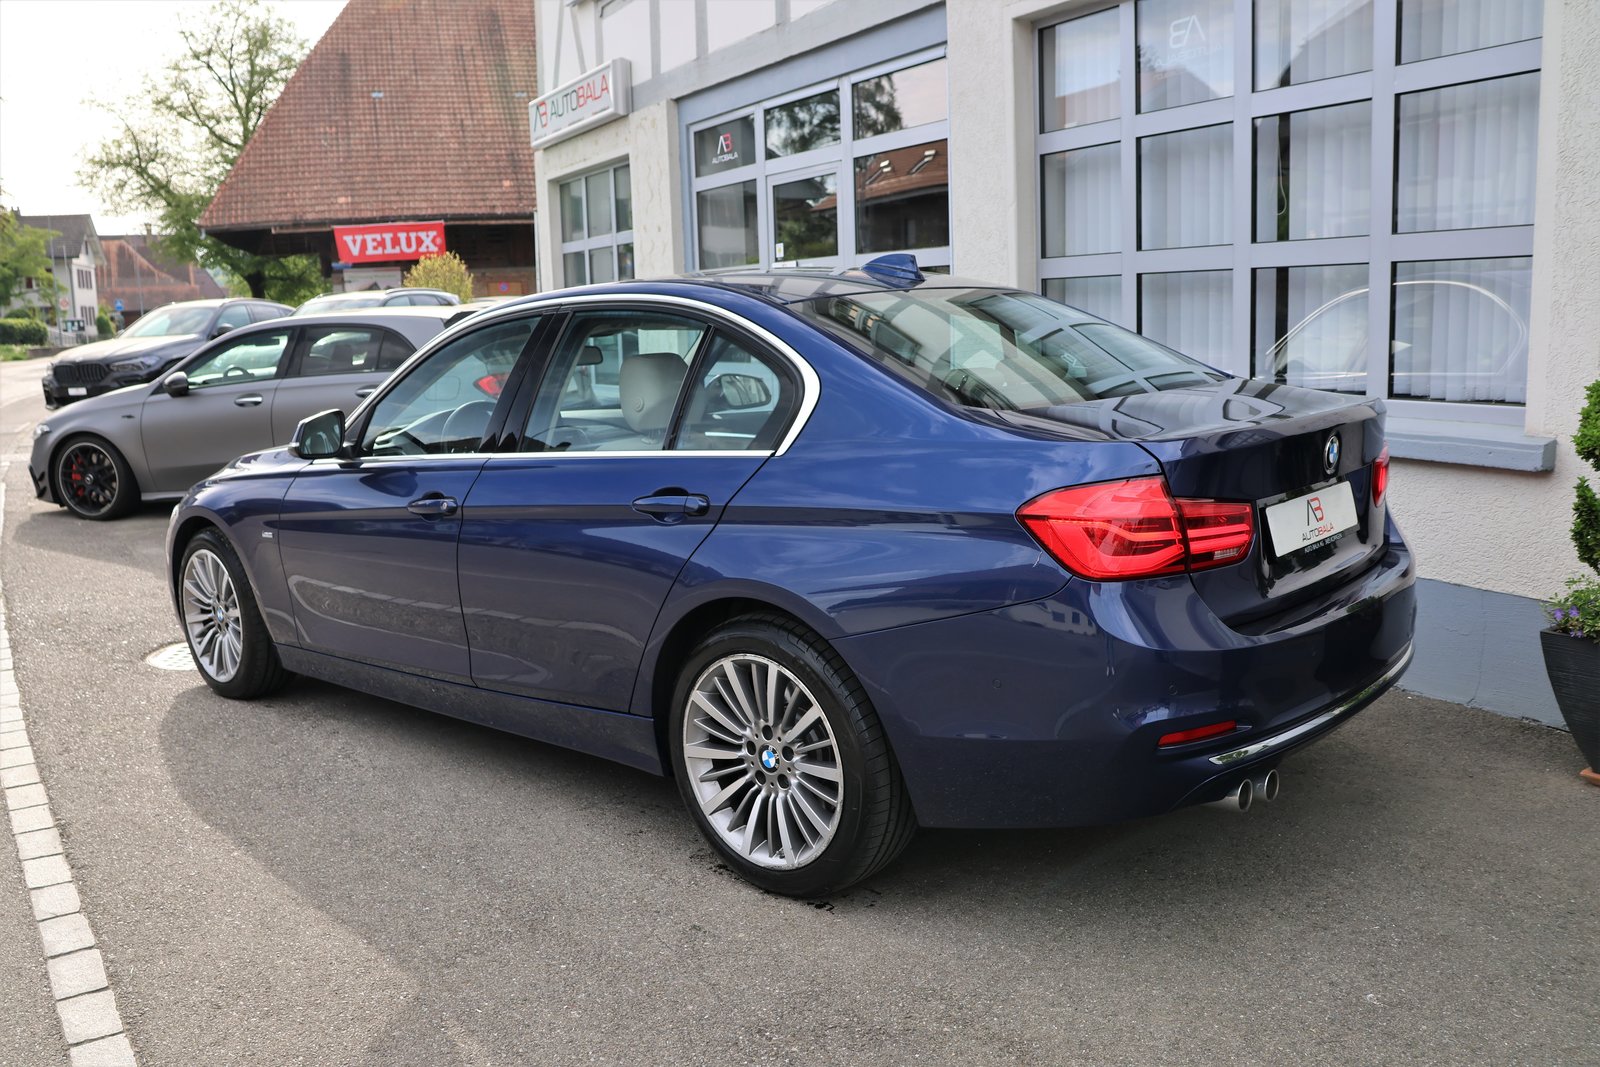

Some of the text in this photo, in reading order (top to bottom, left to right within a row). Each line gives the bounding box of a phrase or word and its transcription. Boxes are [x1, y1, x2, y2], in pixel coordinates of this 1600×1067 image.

[550, 74, 609, 121] AUTOBALA
[711, 152, 738, 164] AUTOBALA
[343, 230, 438, 257] VELUX
[1301, 522, 1334, 542] AUTOBALA
